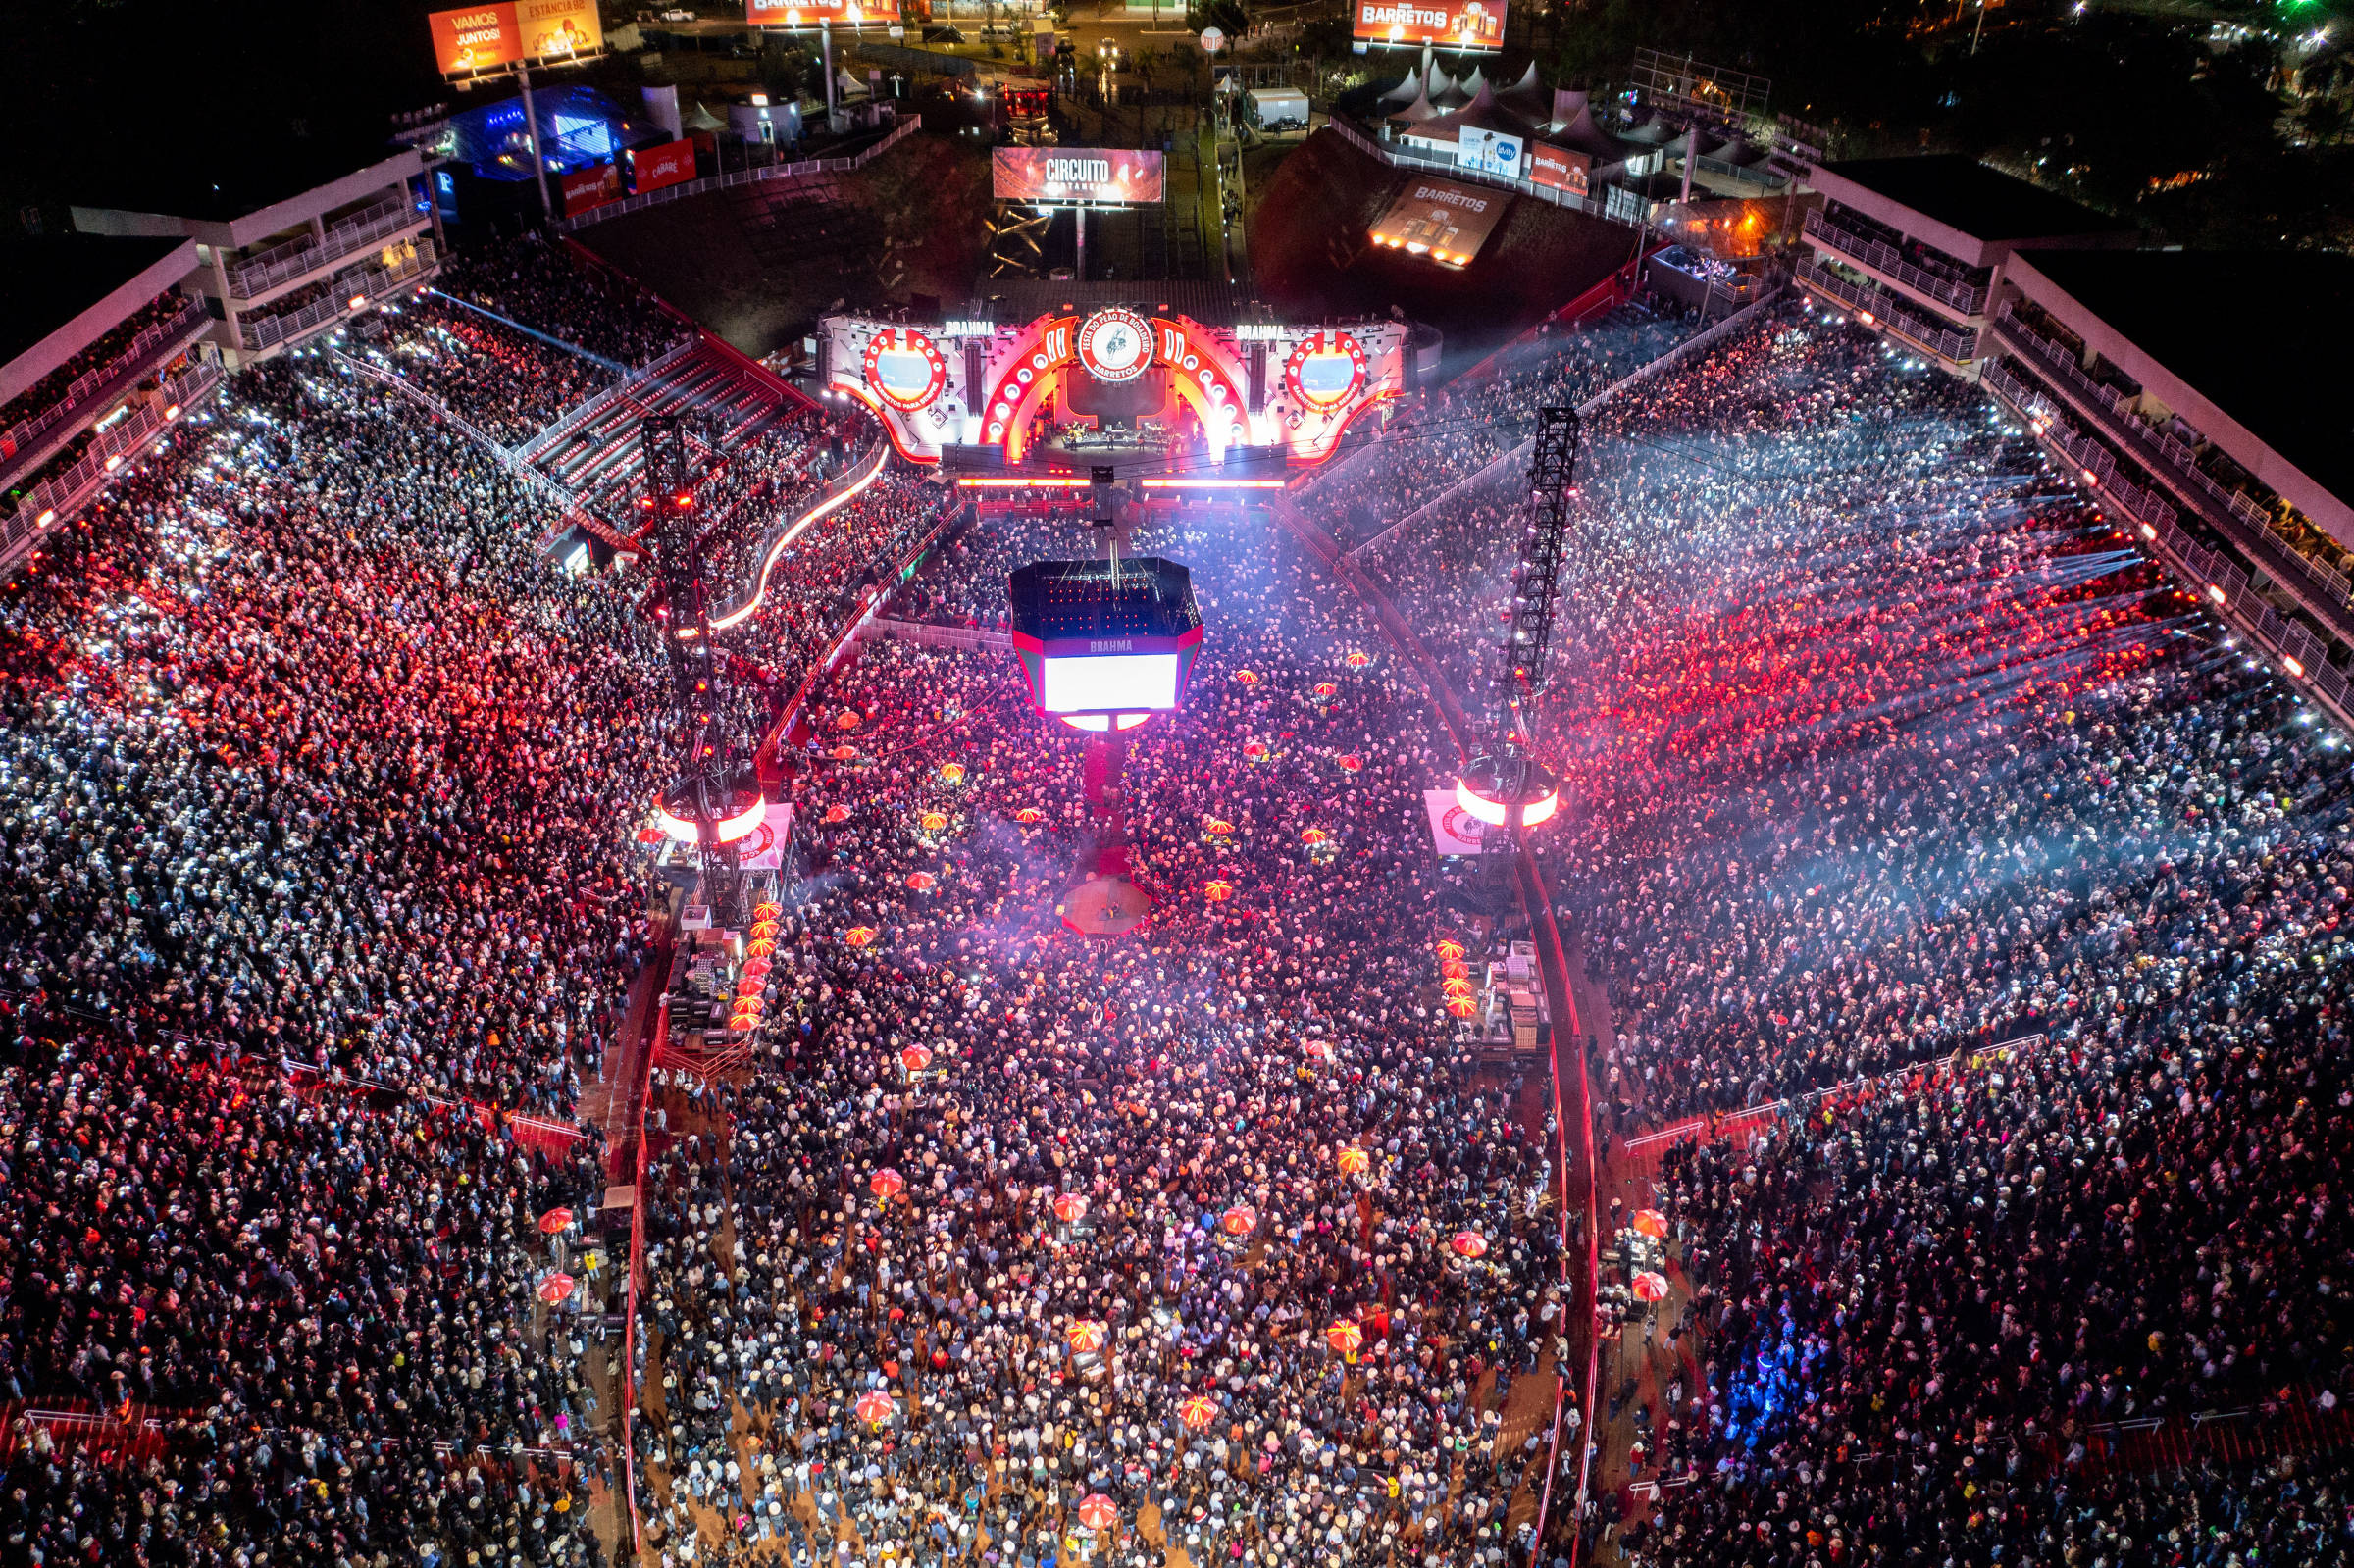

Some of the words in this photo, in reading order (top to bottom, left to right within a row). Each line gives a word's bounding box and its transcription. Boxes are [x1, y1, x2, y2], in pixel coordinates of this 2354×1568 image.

[451, 12, 498, 29] VAMOS
[1362, 6, 1447, 28] BARRETOS
[456, 28, 501, 46] JUNTOS!
[1046, 158, 1109, 182] CIRCUITO
[1535, 157, 1567, 173] BARRETOS
[1414, 186, 1487, 212] BARRETOS
[945, 321, 996, 335] BRAHMA
[1090, 322, 1100, 331] DO
[1119, 313, 1129, 323] DE
[1129, 319, 1150, 353] BOIADEIRO
[1236, 325, 1285, 339] BRAHMA
[1093, 364, 1138, 378] BARRETOS
[1090, 639, 1132, 653] BRAHMA
